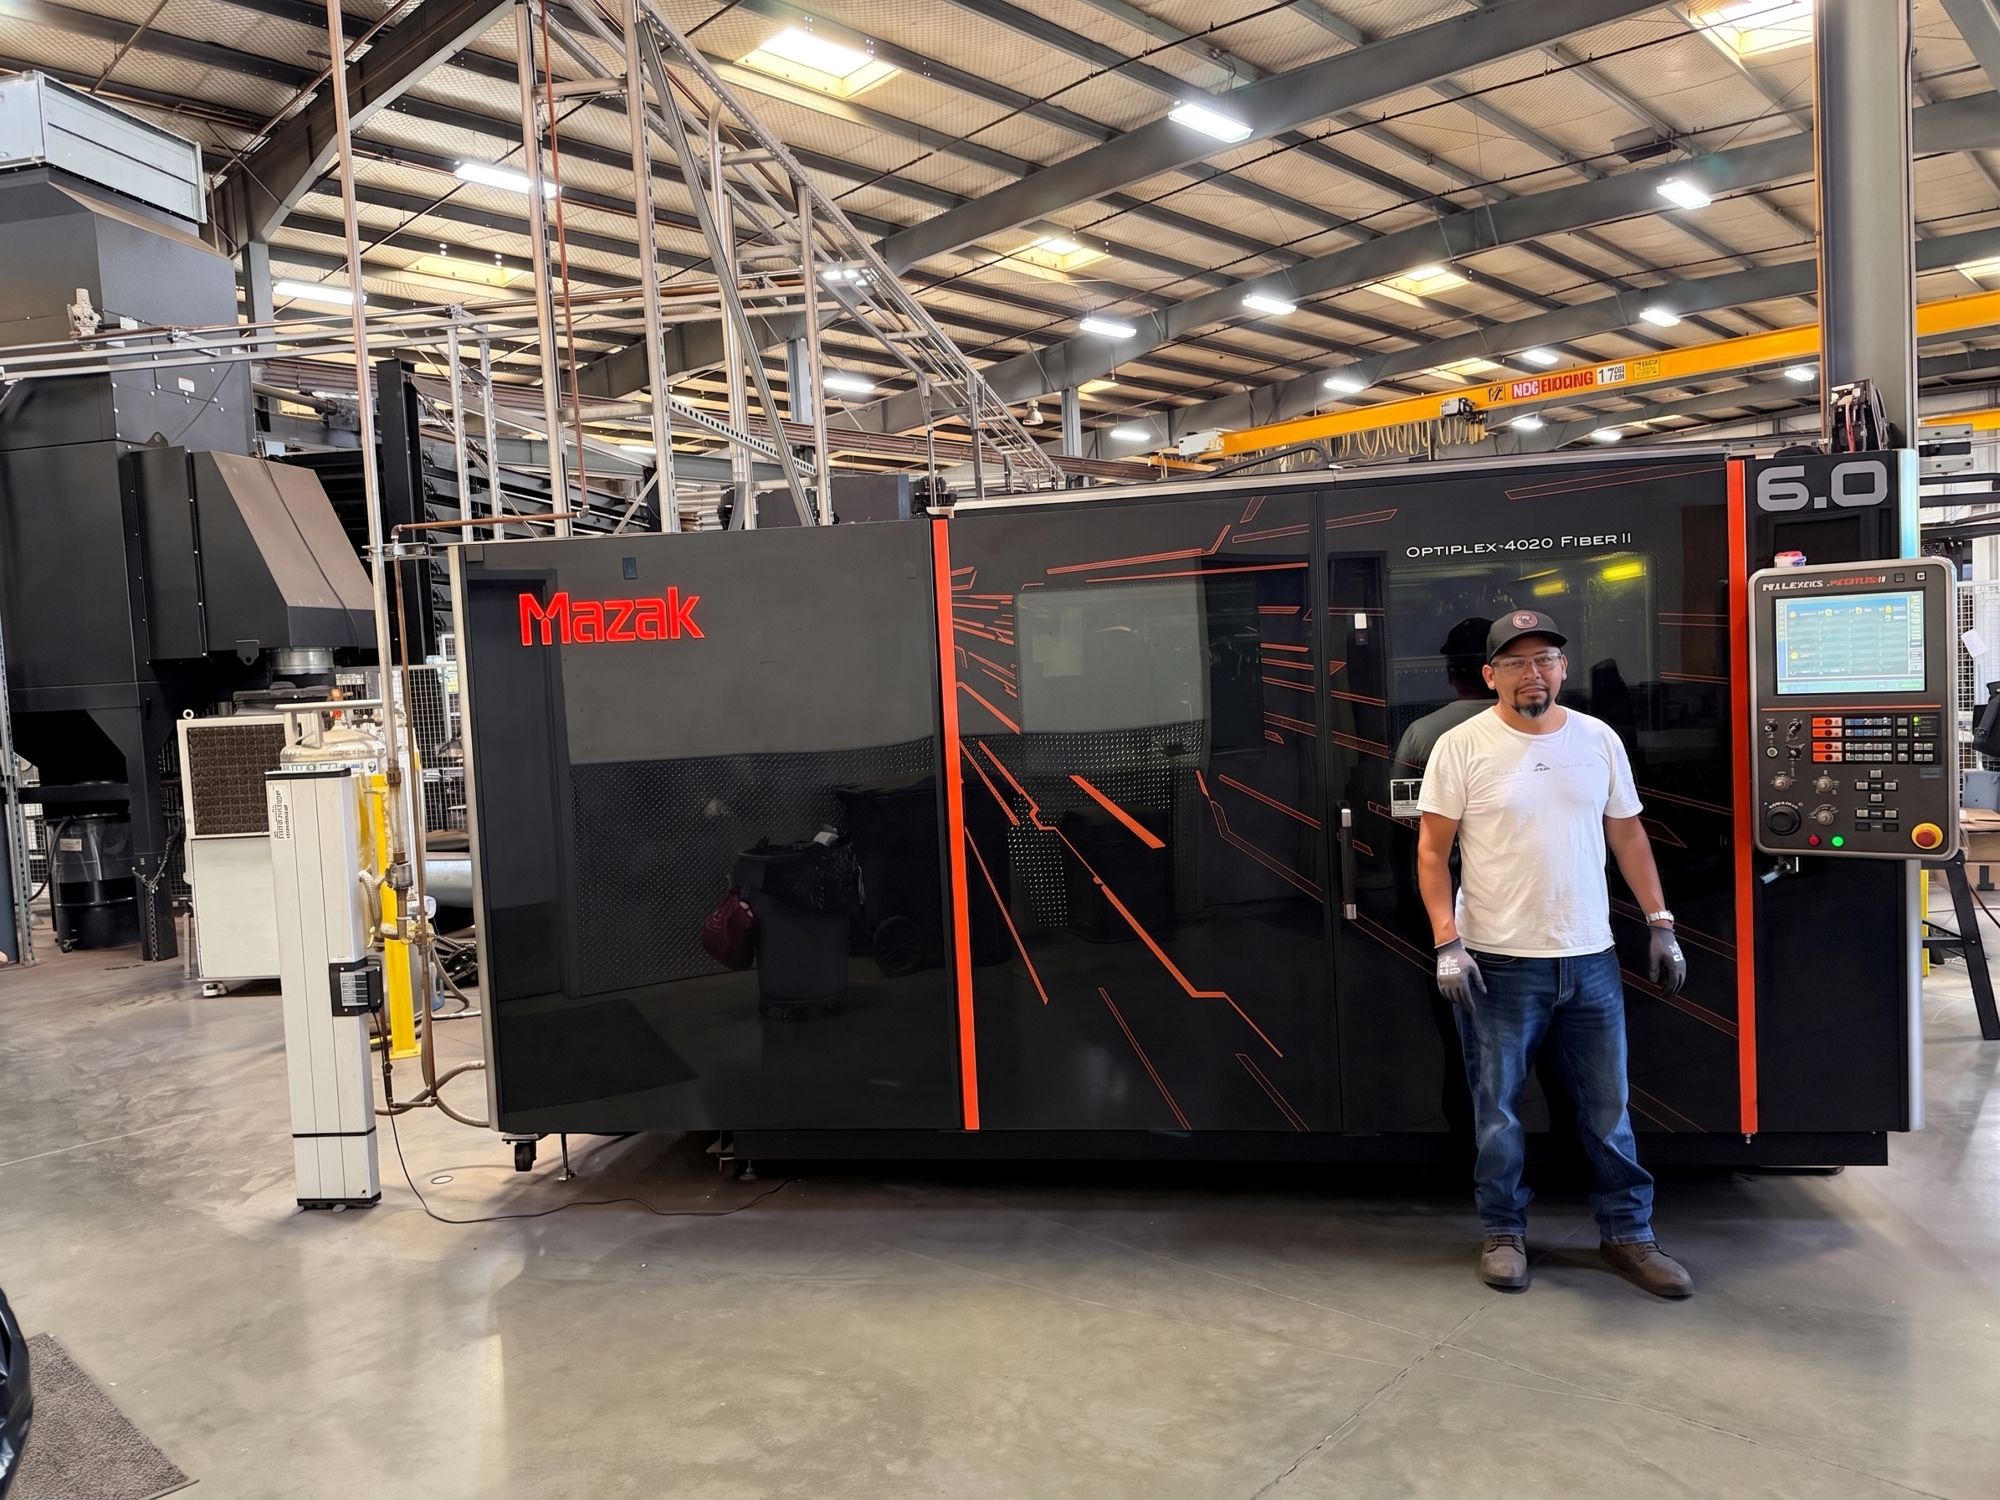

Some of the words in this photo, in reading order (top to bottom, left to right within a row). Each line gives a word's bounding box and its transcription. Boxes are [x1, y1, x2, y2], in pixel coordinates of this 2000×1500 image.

[1757, 460, 1888, 512] 6.0
[1406, 537, 1553, 558] OPTIPLEX-4020
[1561, 534, 1617, 548] FIBER
[518, 586, 705, 647] Mazak
